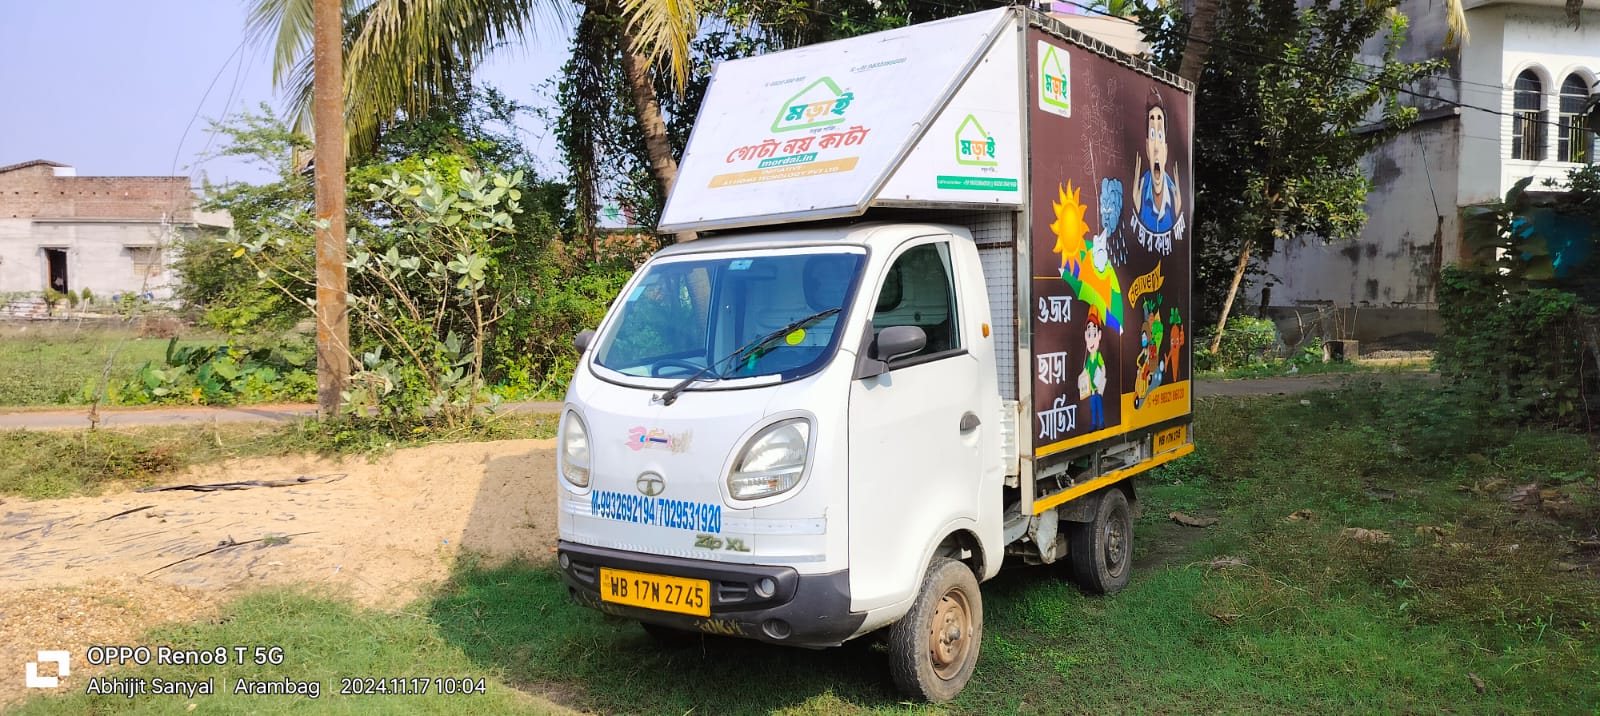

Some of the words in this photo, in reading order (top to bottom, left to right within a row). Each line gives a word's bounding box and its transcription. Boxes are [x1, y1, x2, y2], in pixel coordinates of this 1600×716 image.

[785, 92, 854, 122] মড়াই
[726, 139, 781, 163] গোটা
[783, 136, 816, 154] নয়
[819, 125, 871, 149] কাটা
[960, 136, 995, 160] মড়াই
[1038, 295, 1072, 323] ওজর
[1036, 351, 1067, 385] ছাড়া
[1037, 394, 1077, 440] সার্ভিস
[610, 576, 628, 598] WB
[634, 579, 660, 603] 17N
[665, 584, 704, 608] 2745
